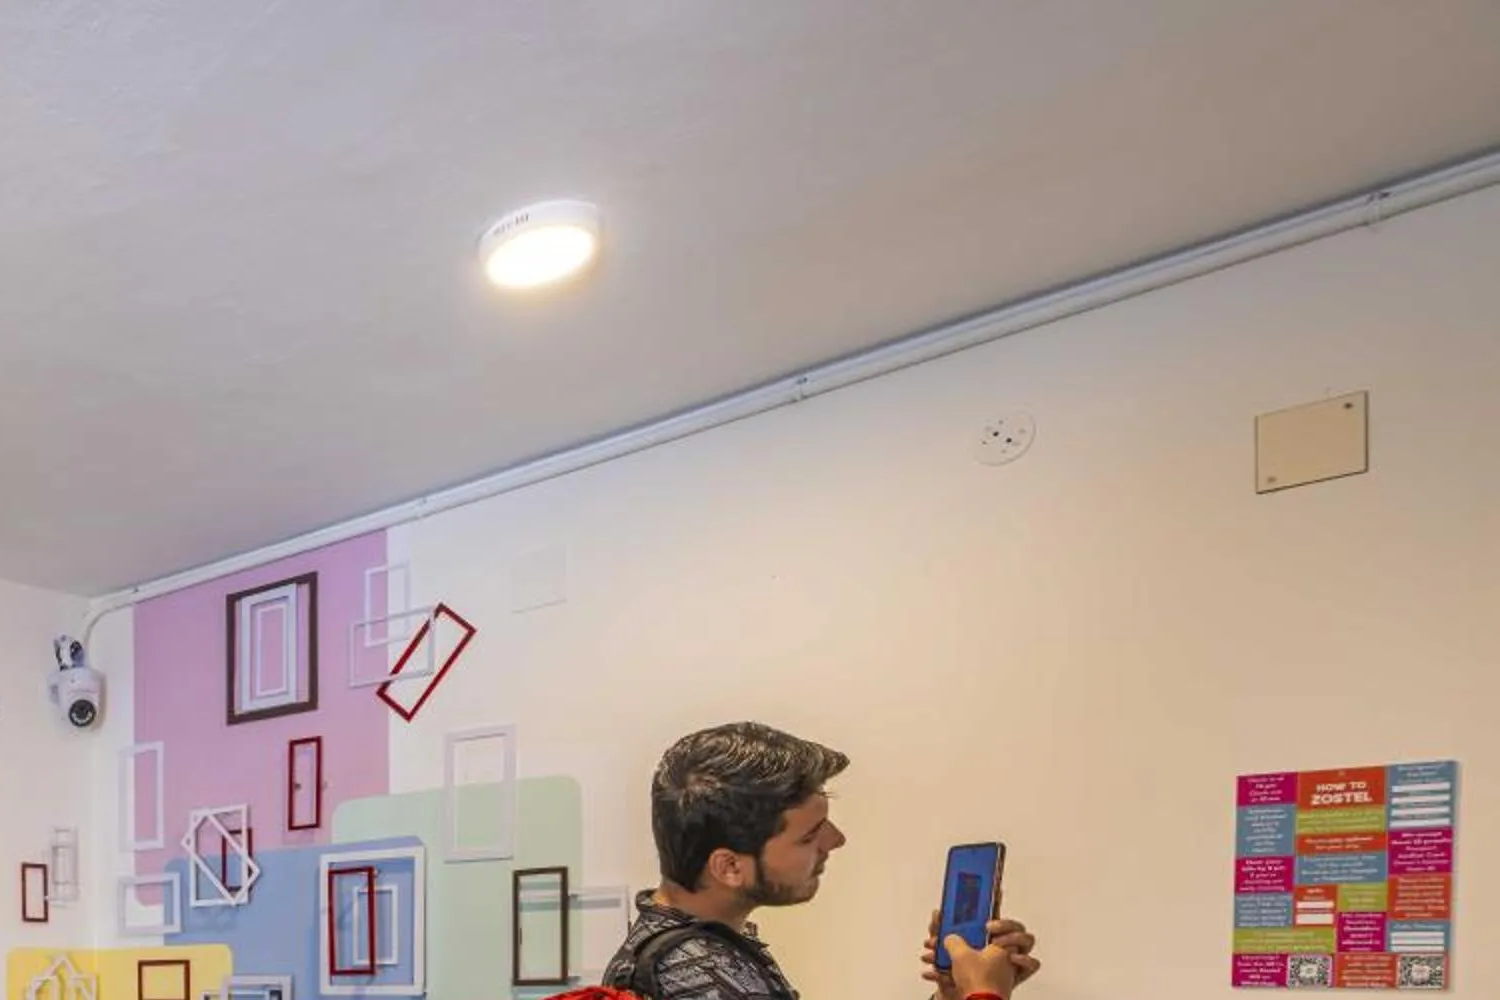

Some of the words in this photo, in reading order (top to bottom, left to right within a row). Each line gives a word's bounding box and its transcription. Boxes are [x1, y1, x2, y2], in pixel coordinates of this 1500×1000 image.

[1315, 783, 1347, 793] HOW
[1349, 781, 1367, 790] TO
[1310, 791, 1373, 806] ZOSTEL
